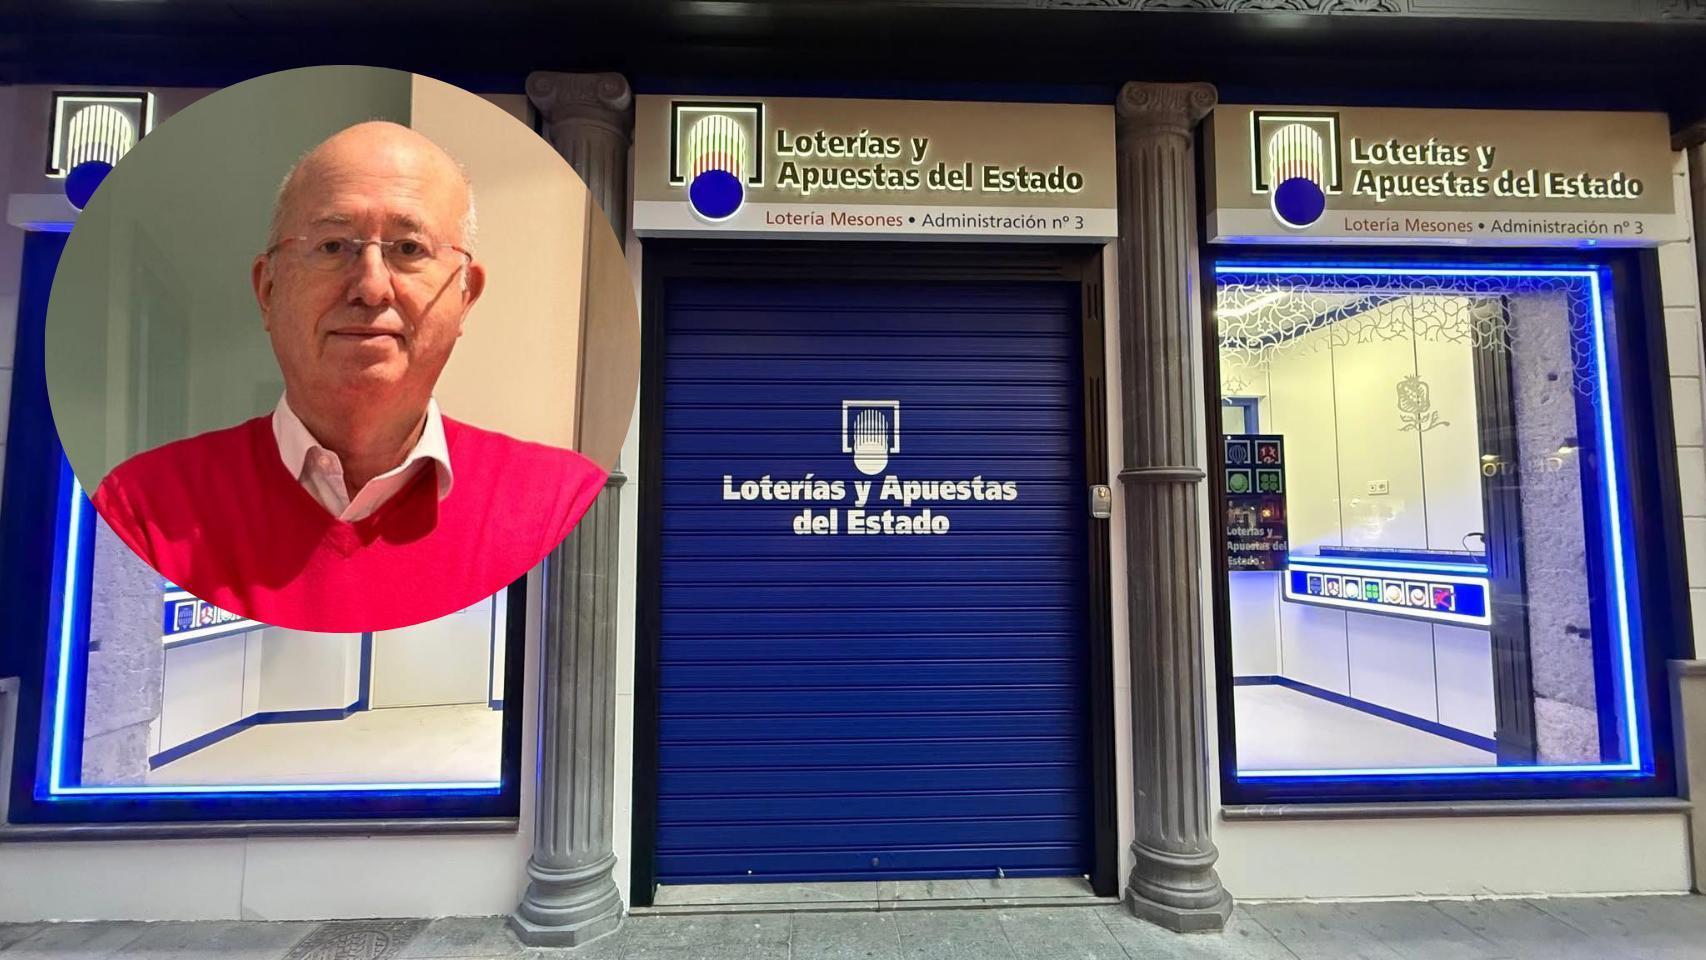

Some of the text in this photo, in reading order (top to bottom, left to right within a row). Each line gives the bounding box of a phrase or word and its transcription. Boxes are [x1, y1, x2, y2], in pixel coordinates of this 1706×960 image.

[777, 128, 929, 164] Loterías y
[1351, 135, 1496, 170] Loterías y
[777, 161, 1084, 194] Apuestas del Estado
[1352, 169, 1644, 202] Apuestas del Estado
[766, 211, 903, 227] Lotería Mesones
[922, 213, 1047, 229] Administración
[1075, 215, 1084, 230] 3
[1344, 217, 1473, 232] Lotería Mesones
[1491, 219, 1608, 234] Administración
[1634, 221, 1644, 235] 3
[723, 473, 1018, 507] Loterías y Apuestas
[793, 509, 950, 534] del Estado
[1227, 541, 1288, 553] Apuestas del
